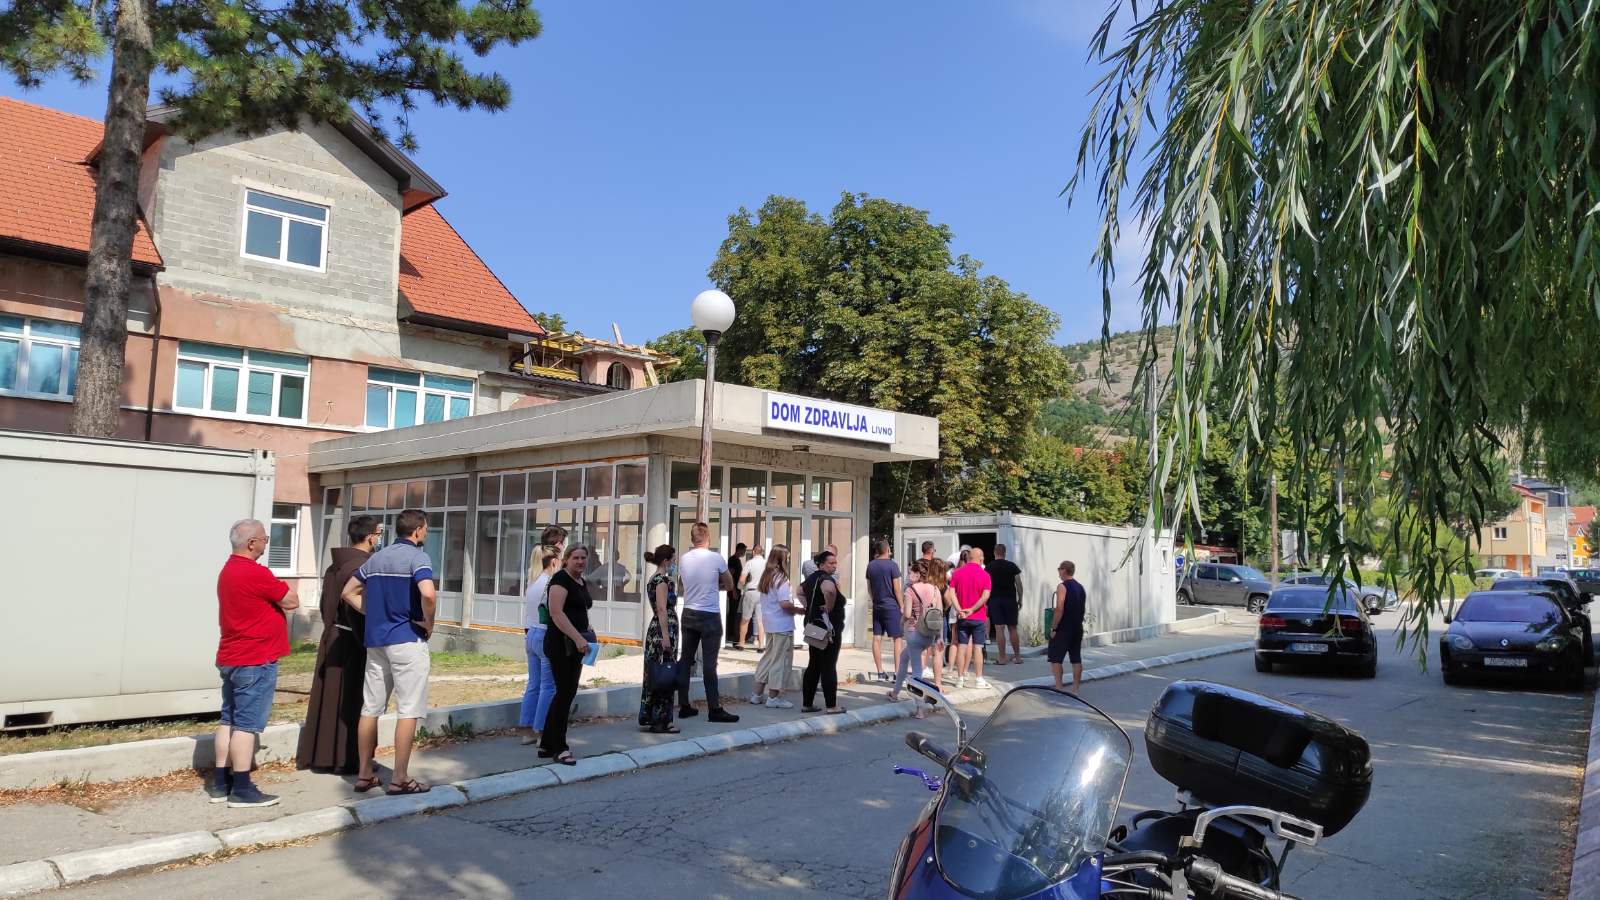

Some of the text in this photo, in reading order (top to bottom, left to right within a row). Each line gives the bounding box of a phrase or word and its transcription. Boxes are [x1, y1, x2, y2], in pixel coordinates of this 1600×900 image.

[771, 401, 892, 436] DOM ZDRAVLJA LIVNO
